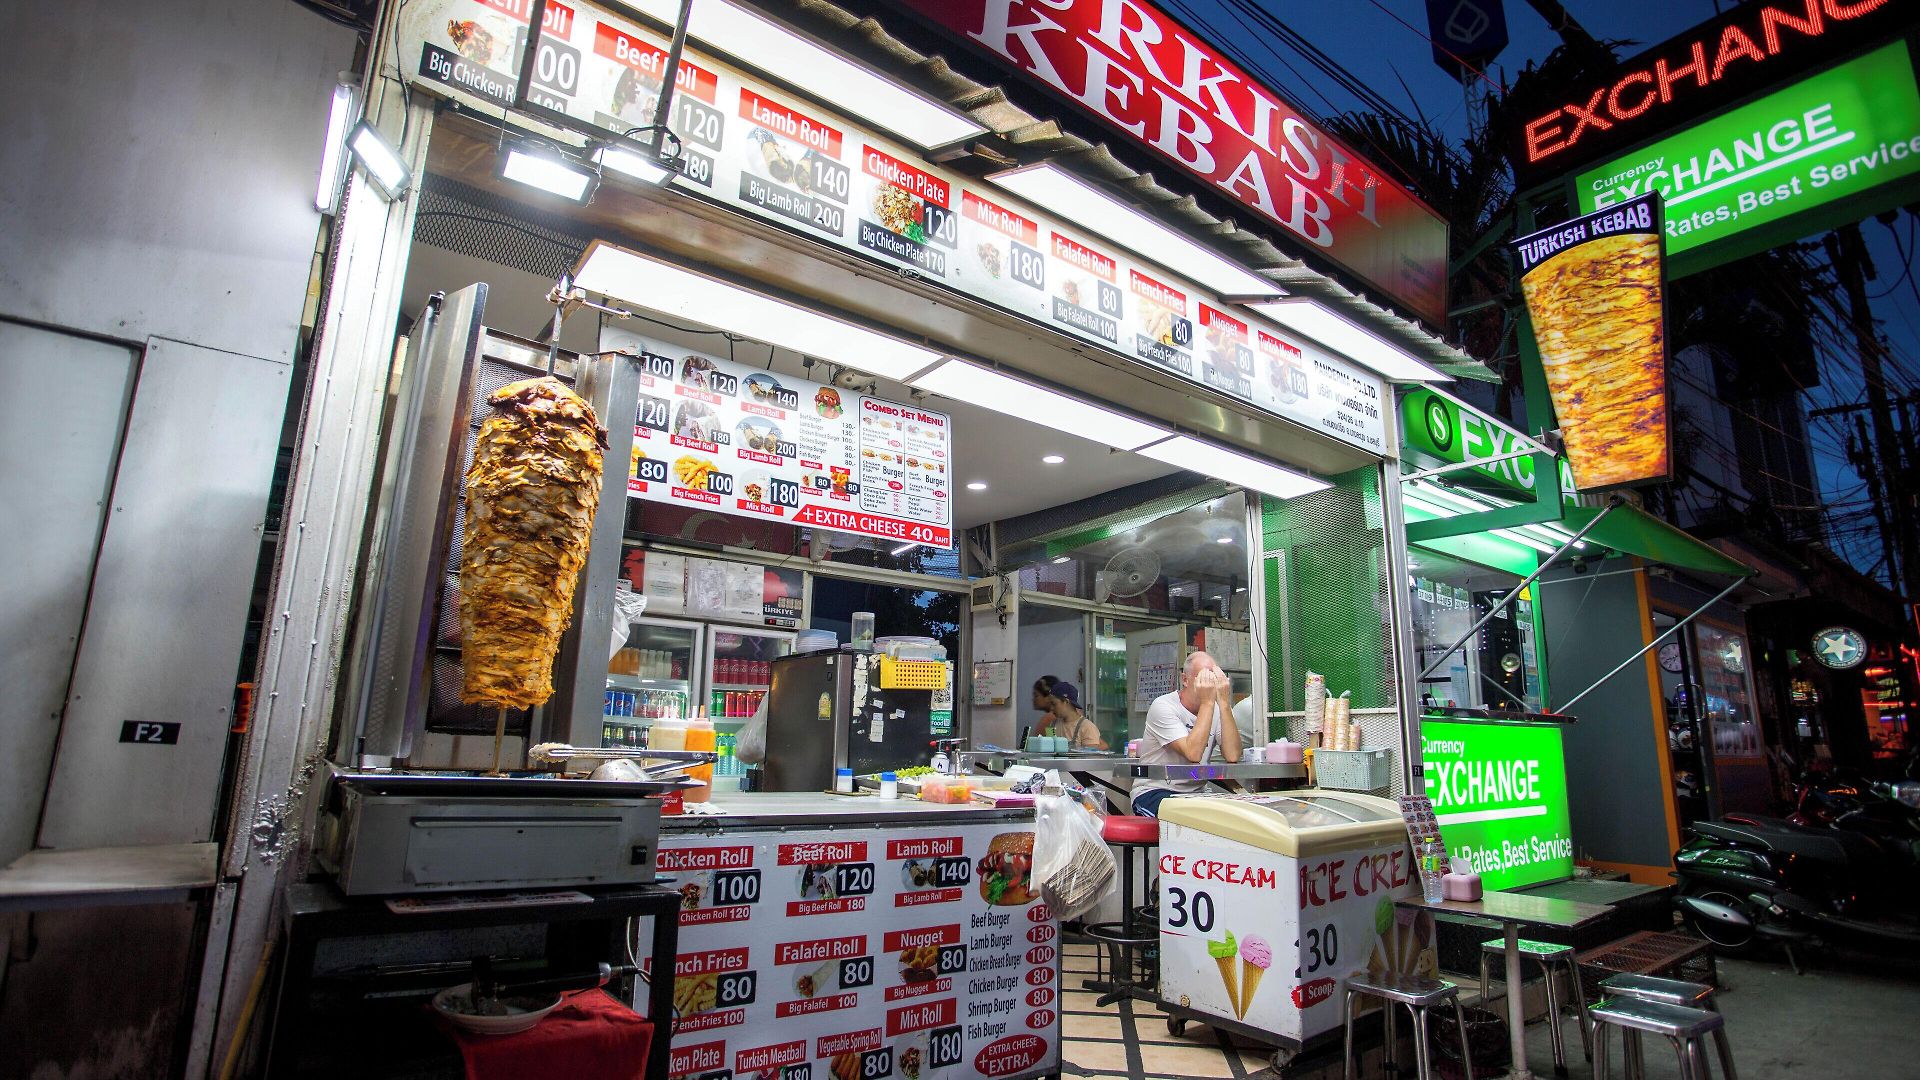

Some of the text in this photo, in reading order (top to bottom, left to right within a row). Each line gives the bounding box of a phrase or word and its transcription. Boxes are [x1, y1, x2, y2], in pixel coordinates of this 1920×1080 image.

[615, 35, 661, 73] Beef
[429, 51, 452, 81] Big
[453, 63, 504, 98] Chicken
[1525, 0, 1891, 162] EXCHAN
[683, 102, 719, 142] 120
[752, 97, 829, 151] Lamb Roll
[967, 0, 1334, 248] KEBAB
[1037, 0, 1382, 228] RKISH
[682, 151, 710, 183] 180
[814, 160, 849, 198] 140
[868, 151, 945, 205] Chicken Plate
[1592, 156, 1665, 191] Currency
[749, 180, 811, 220] Big Lamb Roll
[813, 201, 841, 231] 200
[924, 204, 957, 242] 120
[976, 200, 1022, 237] Mix Roll
[862, 225, 924, 264] Big Chicken Plate
[1518, 202, 1652, 269] TURKISH KEBAB
[924, 250, 944, 274] 170
[1011, 247, 1043, 286] 180
[1056, 239, 1111, 279] Falafel Roll
[1102, 290, 1117, 313] 80
[1132, 273, 1184, 312] French Fries
[1100, 316, 1116, 342] 100
[1175, 320, 1188, 344] 80
[1209, 310, 1238, 338] Nugget
[643, 353, 672, 378] 100
[1178, 353, 1191, 374] 100
[1239, 350, 1250, 371] 80
[711, 373, 736, 395] 120
[1292, 372, 1306, 395] 180
[775, 390, 797, 408] 140
[637, 399, 665, 428] 120
[674, 435, 715, 453] Big Beef Roll
[712, 431, 728, 446] 180
[776, 443, 795, 458] 200
[739, 450, 781, 466] Big Lamb Roll
[640, 461, 664, 481] 80
[817, 478, 828, 487] 80
[882, 465, 904, 479] Burger
[925, 474, 945, 488] Burger
[708, 473, 732, 495] 100
[771, 482, 797, 506] 180
[848, 483, 858, 492] 80
[745, 501, 775, 515] Mix Roll
[860, 516, 906, 537] CHEESE
[909, 524, 934, 542] 40
[934, 536, 949, 545] BAHT
[134, 722, 164, 742] F2
[1421, 736, 1464, 757] Currency
[1424, 759, 1546, 806] EXCHANGE
[656, 847, 749, 869] Chicken Roll
[793, 844, 852, 864] Beef Roll
[897, 839, 953, 858] Lamb Roll
[1531, 833, 1573, 863] Service
[838, 866, 873, 893] 120
[940, 861, 969, 881] 140
[1191, 858, 1277, 890] CREAM
[717, 875, 758, 901] 100
[1300, 860, 1347, 910] ICE
[680, 910, 728, 923] Chicken Roll
[729, 906, 749, 919] 120
[799, 901, 842, 915] Big Beef Roll
[846, 898, 864, 912] 180
[1167, 886, 1215, 933] 30
[971, 906, 1051, 929] Beef Burger 130
[900, 929, 944, 948] Nugget
[970, 928, 1052, 951] Lamb Burger 130
[1306, 923, 1339, 974] 30
[782, 940, 859, 963] Falafel Roll
[941, 949, 964, 970] 80
[969, 949, 1051, 973] Chicken Breast Burger 100
[844, 961, 870, 984] 80
[968, 969, 1048, 995] Chicken Burger 80
[722, 976, 752, 1001] 80
[894, 980, 951, 999] Big Nugget 100
[1308, 983, 1333, 1000] Scoop
[789, 995, 857, 1015] Big Falafel 100
[968, 989, 1048, 1019] Shrimp Burger 80
[723, 1012, 744, 1025] 100
[900, 1003, 942, 1030] Mix Roll
[967, 1011, 1048, 1041] Fish Burger 80
[818, 1030, 882, 1057] Vegetable Spring Roll
[931, 1031, 962, 1064] 180
[988, 1037, 1037, 1058] EXTRA CHEESE
[738, 1043, 805, 1071] Turkish Meatball
[864, 1053, 888, 1076] 80
